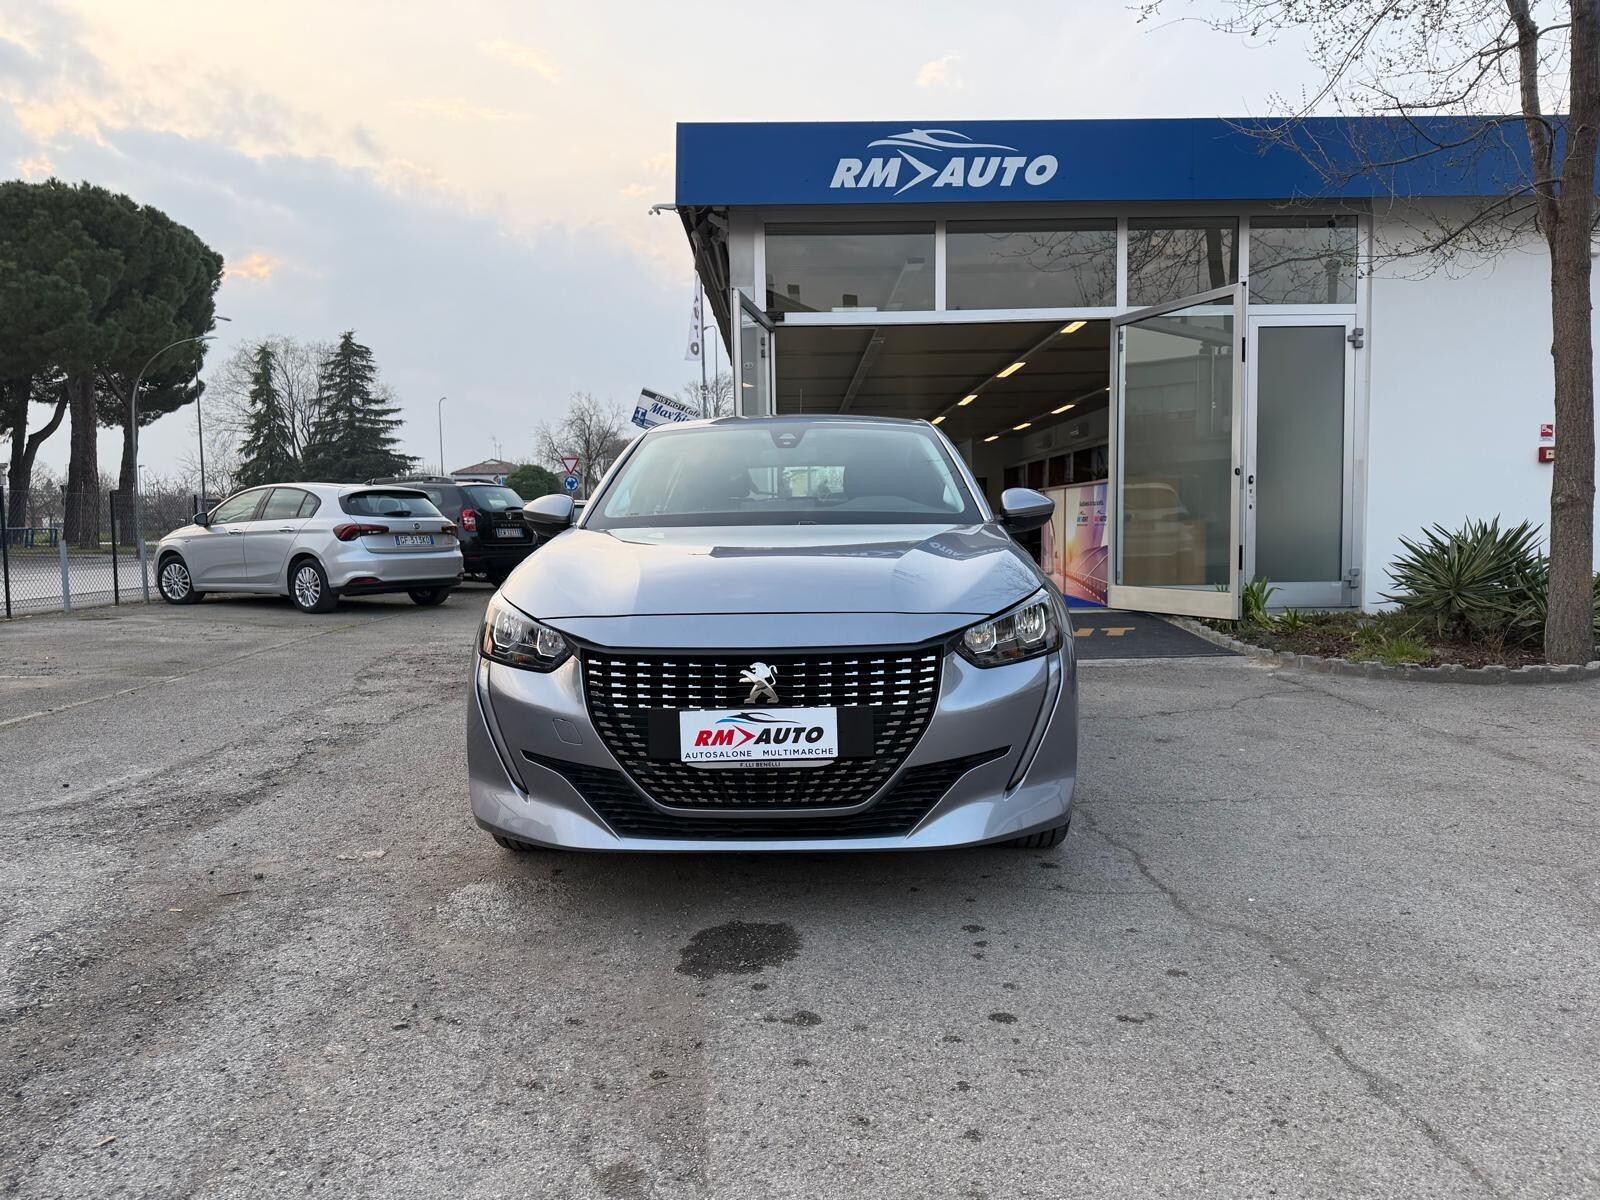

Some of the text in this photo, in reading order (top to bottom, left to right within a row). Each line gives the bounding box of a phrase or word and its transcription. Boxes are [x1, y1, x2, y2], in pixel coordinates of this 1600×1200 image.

[829, 154, 1059, 189] RM AUTO
[655, 394, 684, 412] BISTROT
[694, 726, 825, 747] RM AUTO
[684, 747, 834, 760] AUTOSALONE MULTIMARCHE
